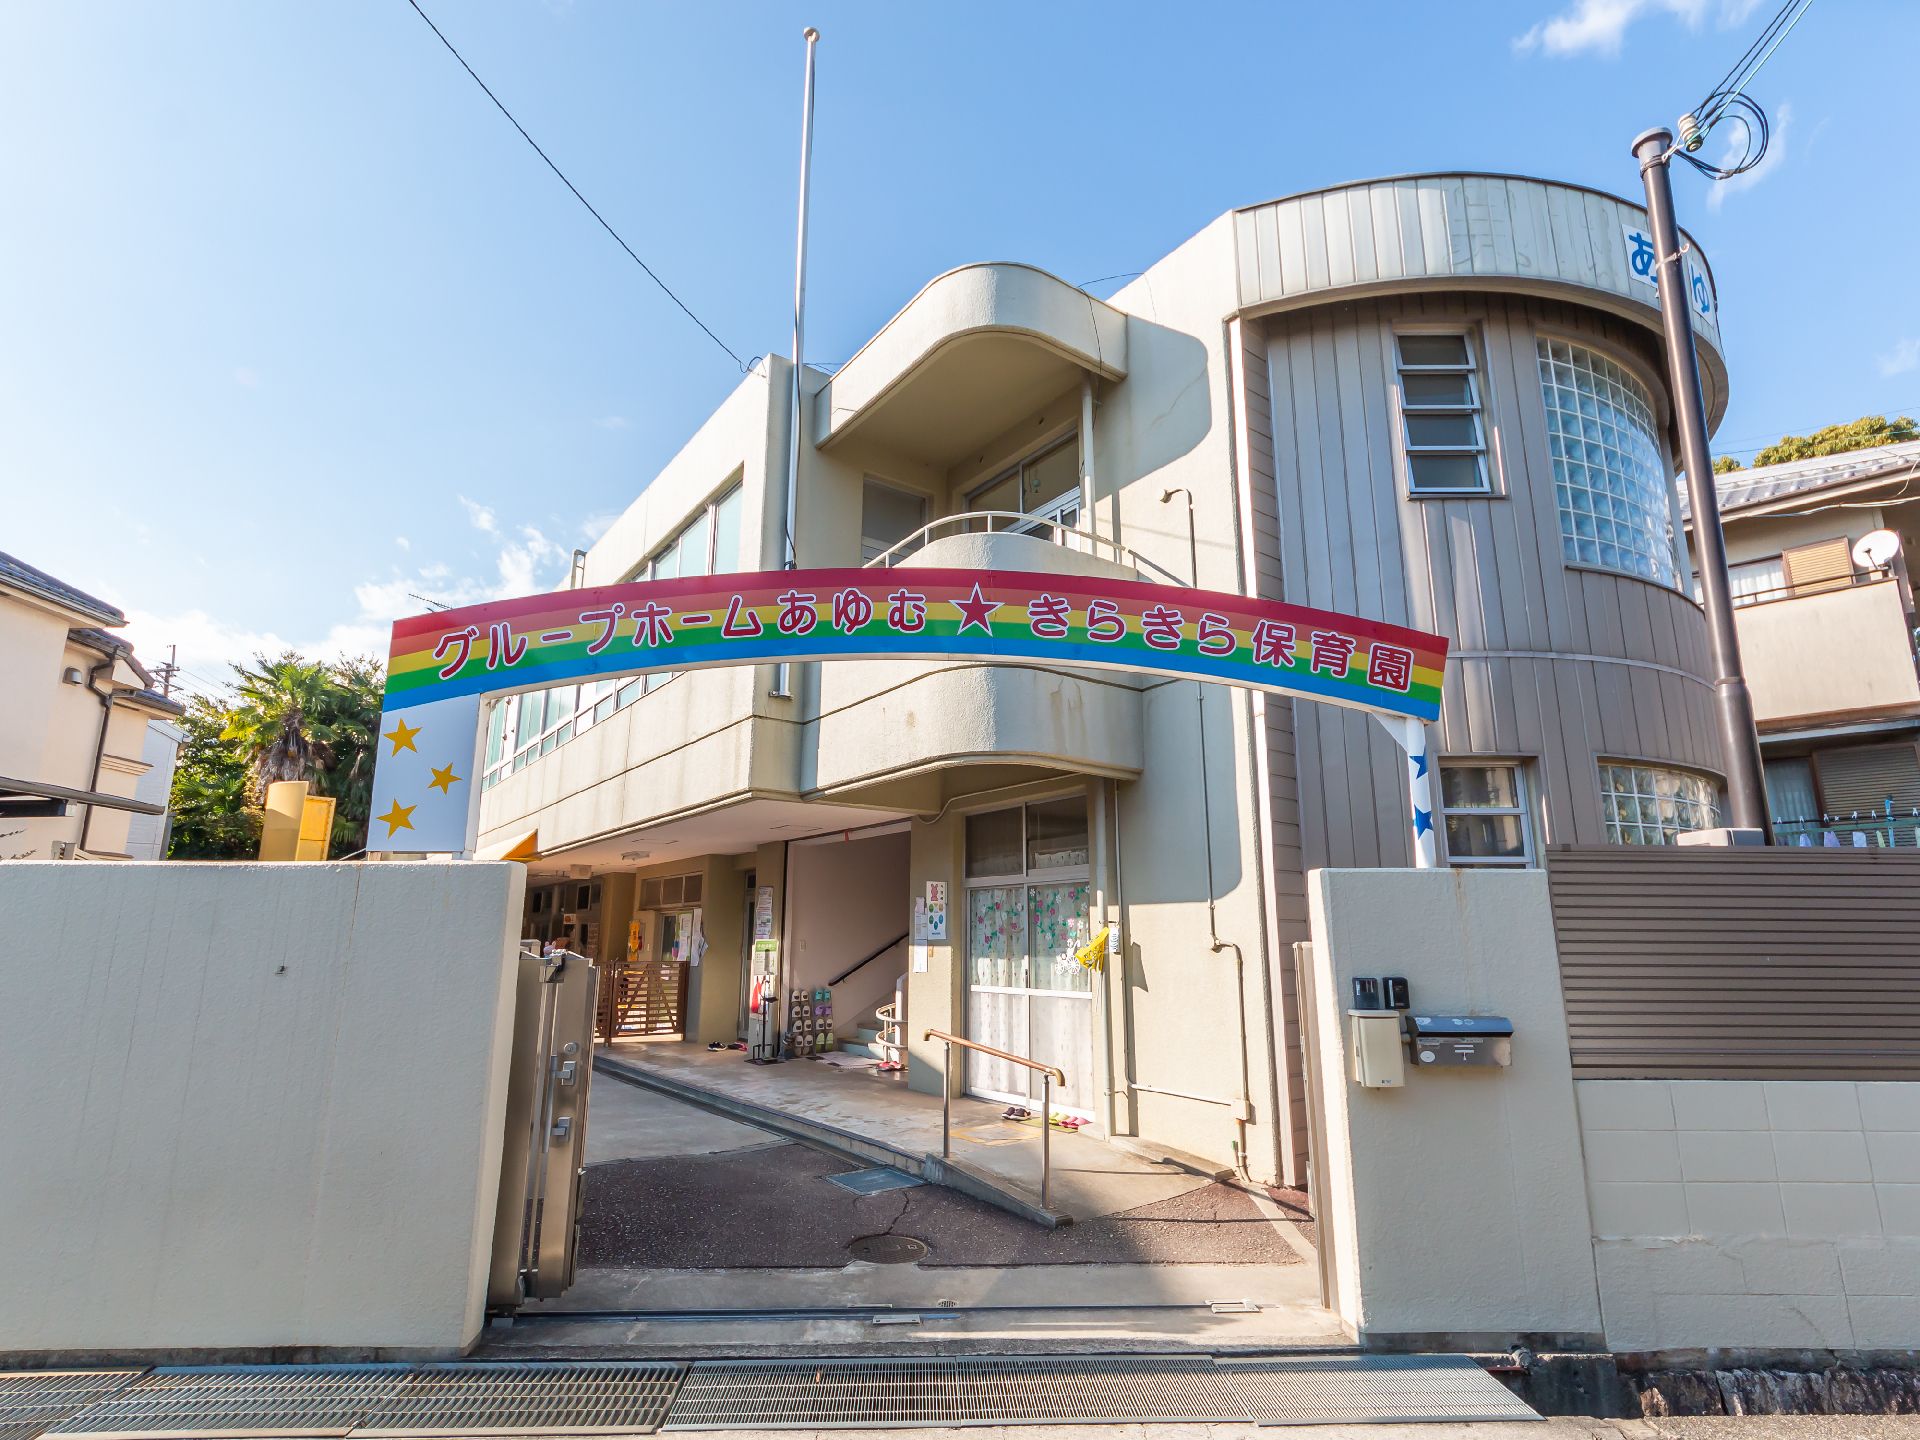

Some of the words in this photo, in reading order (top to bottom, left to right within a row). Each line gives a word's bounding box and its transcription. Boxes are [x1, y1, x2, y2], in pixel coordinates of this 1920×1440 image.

[434, 587, 928, 680] グループホームあゆむ
[1027, 593, 1415, 694] きらきら保育園
